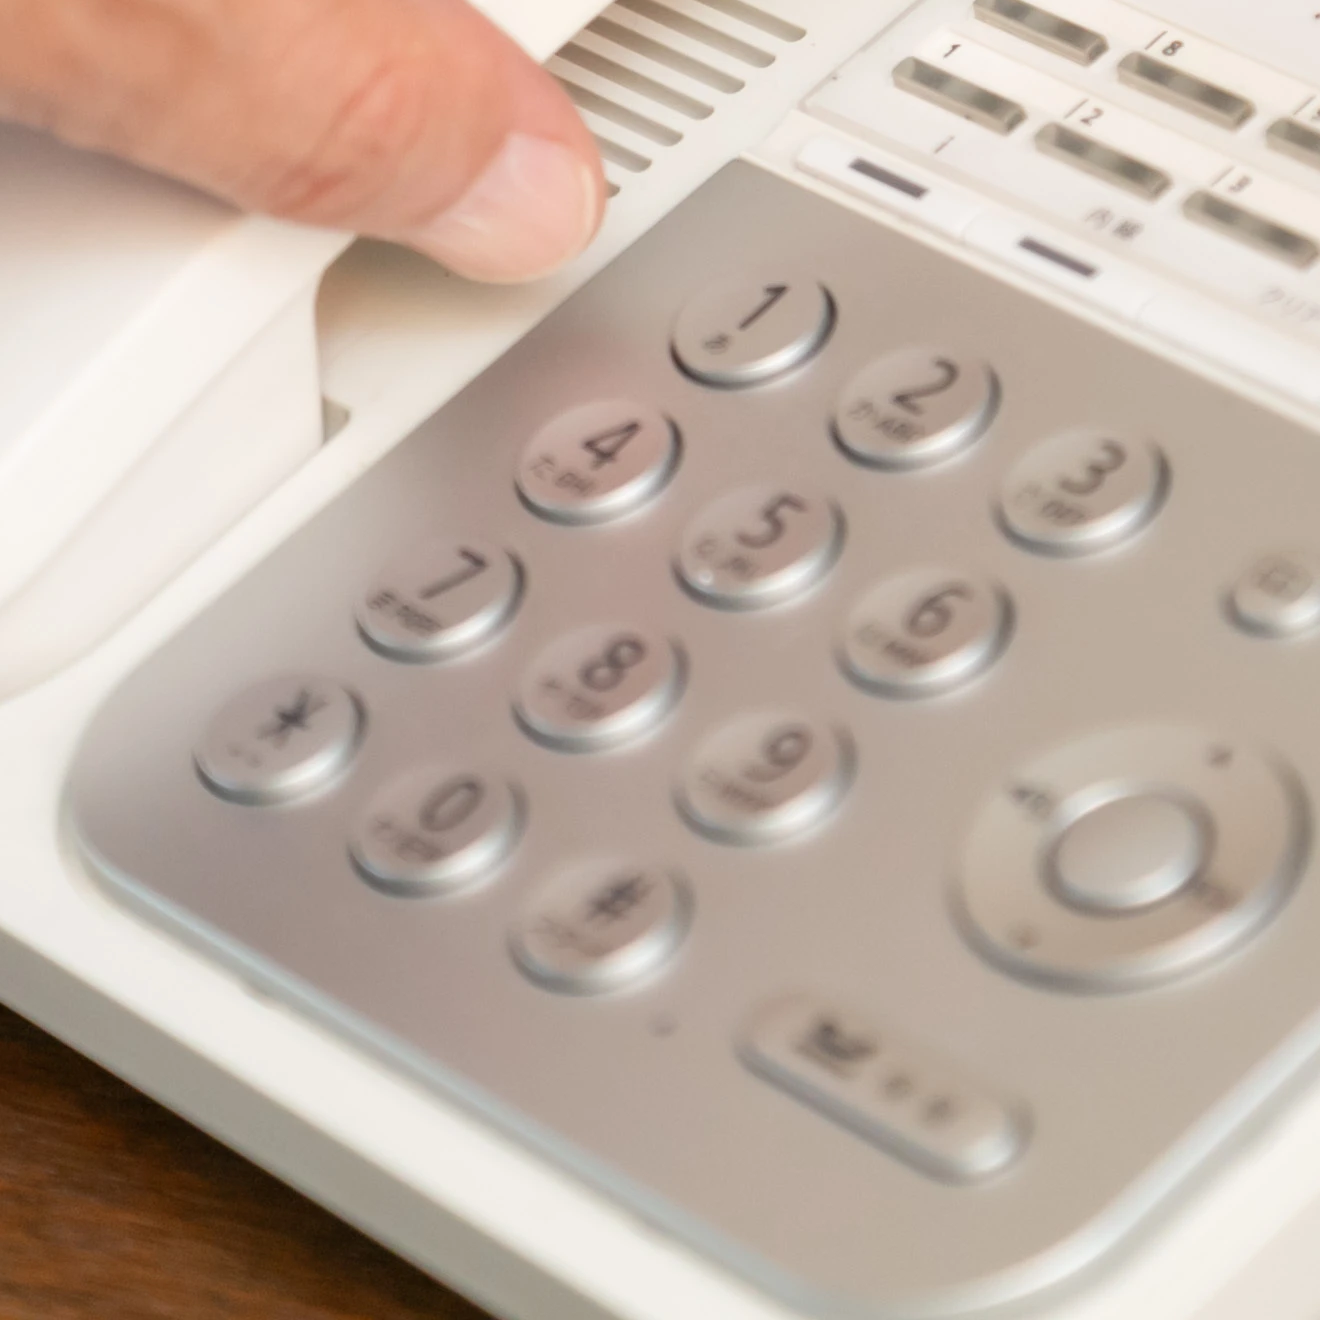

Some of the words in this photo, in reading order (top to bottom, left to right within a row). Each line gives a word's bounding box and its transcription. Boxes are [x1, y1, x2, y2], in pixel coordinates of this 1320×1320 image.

[943, 43, 961, 58] 1
[1162, 40, 1184, 57] 8
[1080, 107, 1104, 126] 2
[738, 285, 788, 331] 1
[891, 358, 958, 415] 2
[583, 419, 641, 471] 4
[1060, 441, 1126, 495] 3
[737, 494, 806, 549] 5
[420, 545, 488, 600] 7
[907, 584, 972, 639] 6
[579, 630, 647, 691] 8
[740, 721, 809, 783] 9
[418, 773, 483, 833] 0
